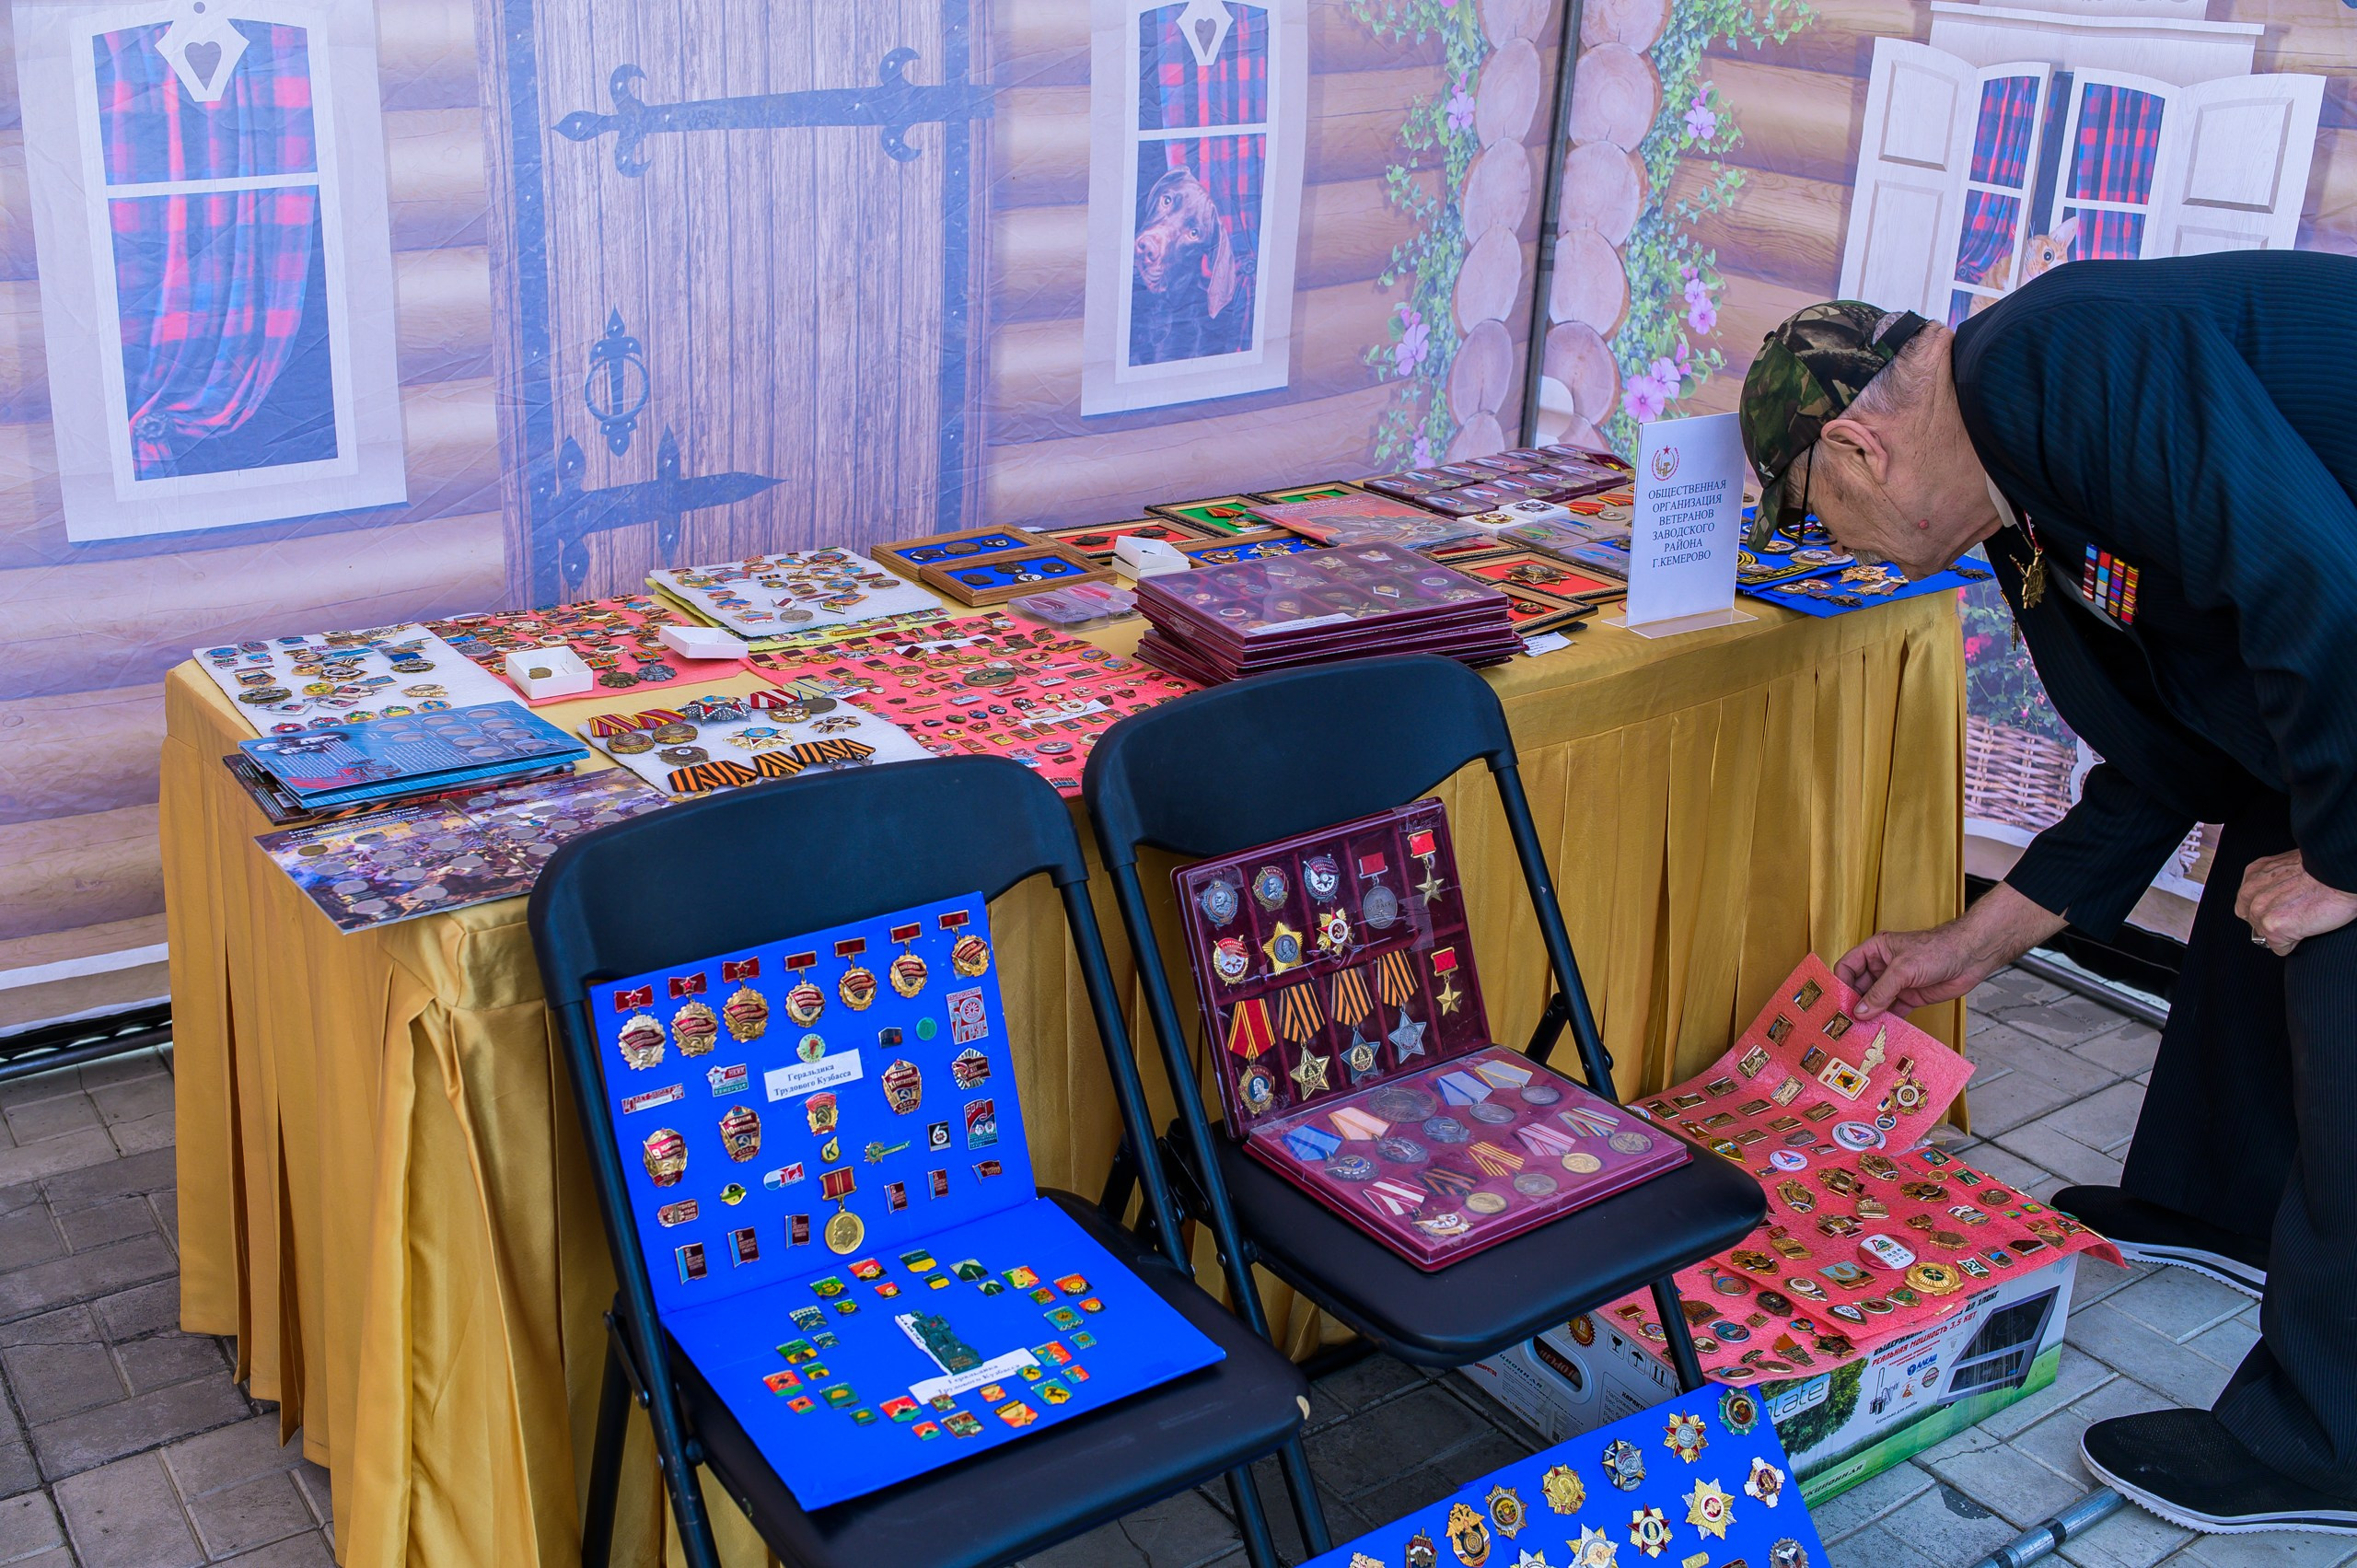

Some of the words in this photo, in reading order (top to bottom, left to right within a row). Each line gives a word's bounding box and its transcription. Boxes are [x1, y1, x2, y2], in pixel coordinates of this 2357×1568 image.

[1648, 479, 1726, 500] ОБЩЕСТВЕННАЯ
[1652, 494, 1722, 514] ОРГАНИЗАЦИЯ
[1658, 509, 1714, 527] ВЕТЕРАНОВ
[1652, 522, 1715, 541] ЗАВОДСКОГО
[1664, 538, 1702, 553] РАЙОНА
[1652, 550, 1712, 569] Г.КЕМЕРОВО
[787, 1064, 834, 1082] Геральдика
[773, 1081, 816, 1097] Трудового
[817, 1071, 852, 1086] Кузбасса
[1902, 1091, 1914, 1101] 60
[1872, 1343, 1909, 1366] РЕАЛЬНАЯ
[1910, 1325, 1948, 1349] МОЩНОСТЬ
[1949, 1317, 1962, 1330] 3,5
[1963, 1311, 1978, 1323] КВТ
[1499, 1353, 1543, 1389] ЦИОННАЯ
